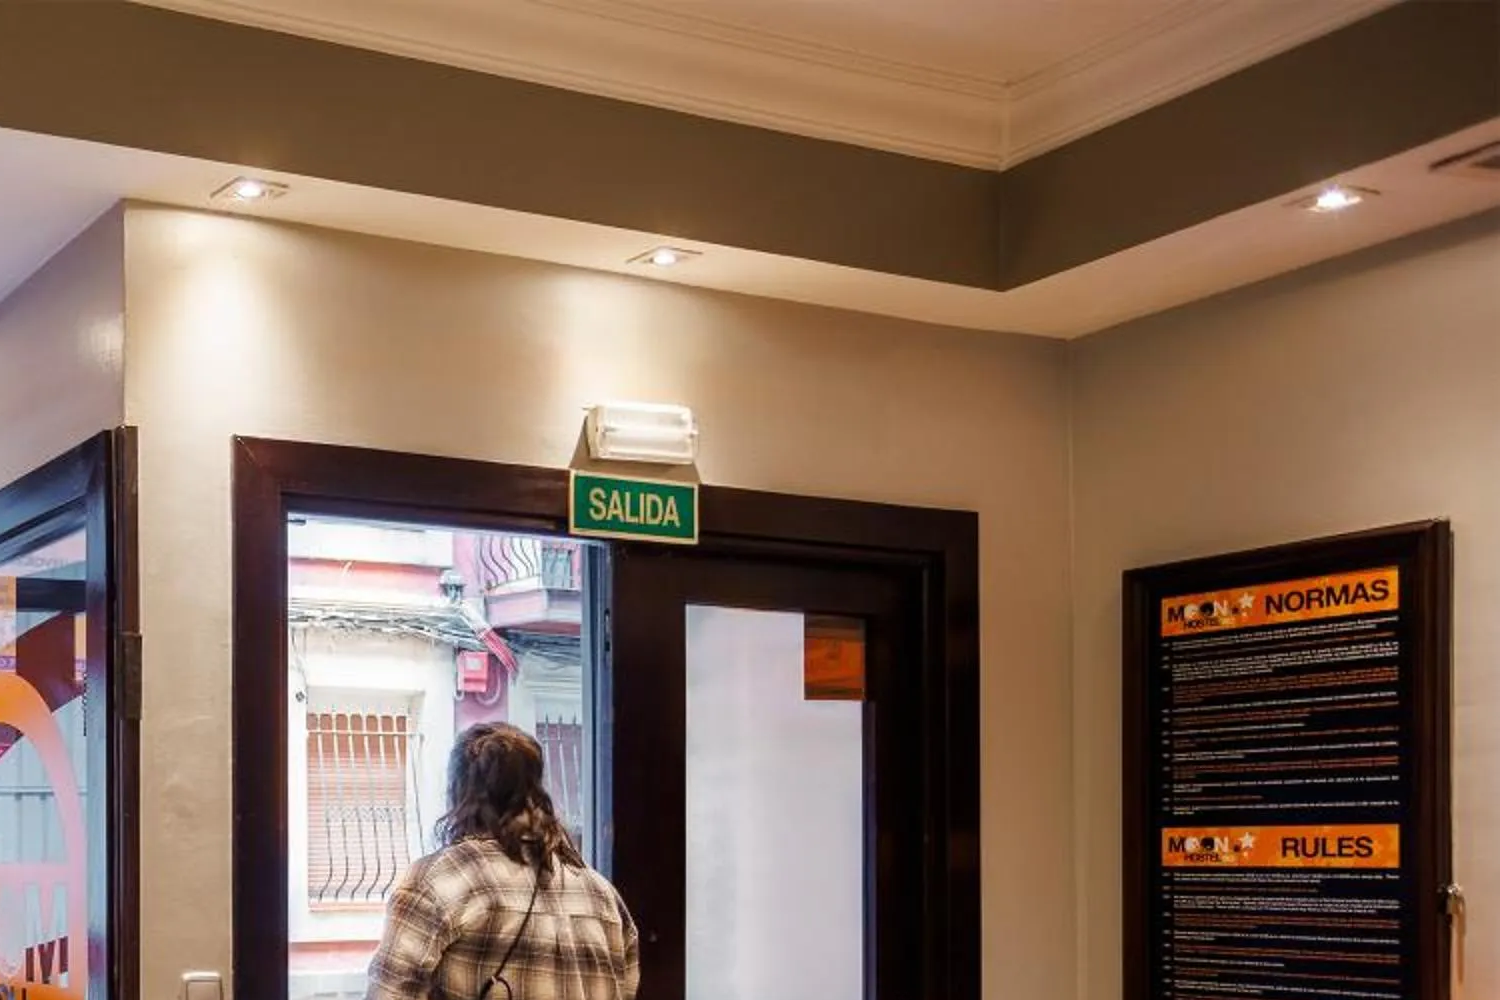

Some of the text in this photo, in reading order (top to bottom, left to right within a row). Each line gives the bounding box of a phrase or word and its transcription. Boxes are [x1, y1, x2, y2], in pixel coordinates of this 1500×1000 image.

[589, 488, 680, 527] SALIDA
[1167, 579, 1389, 622] MOON NORMAS
[1169, 836, 1373, 859] MOON RULES
